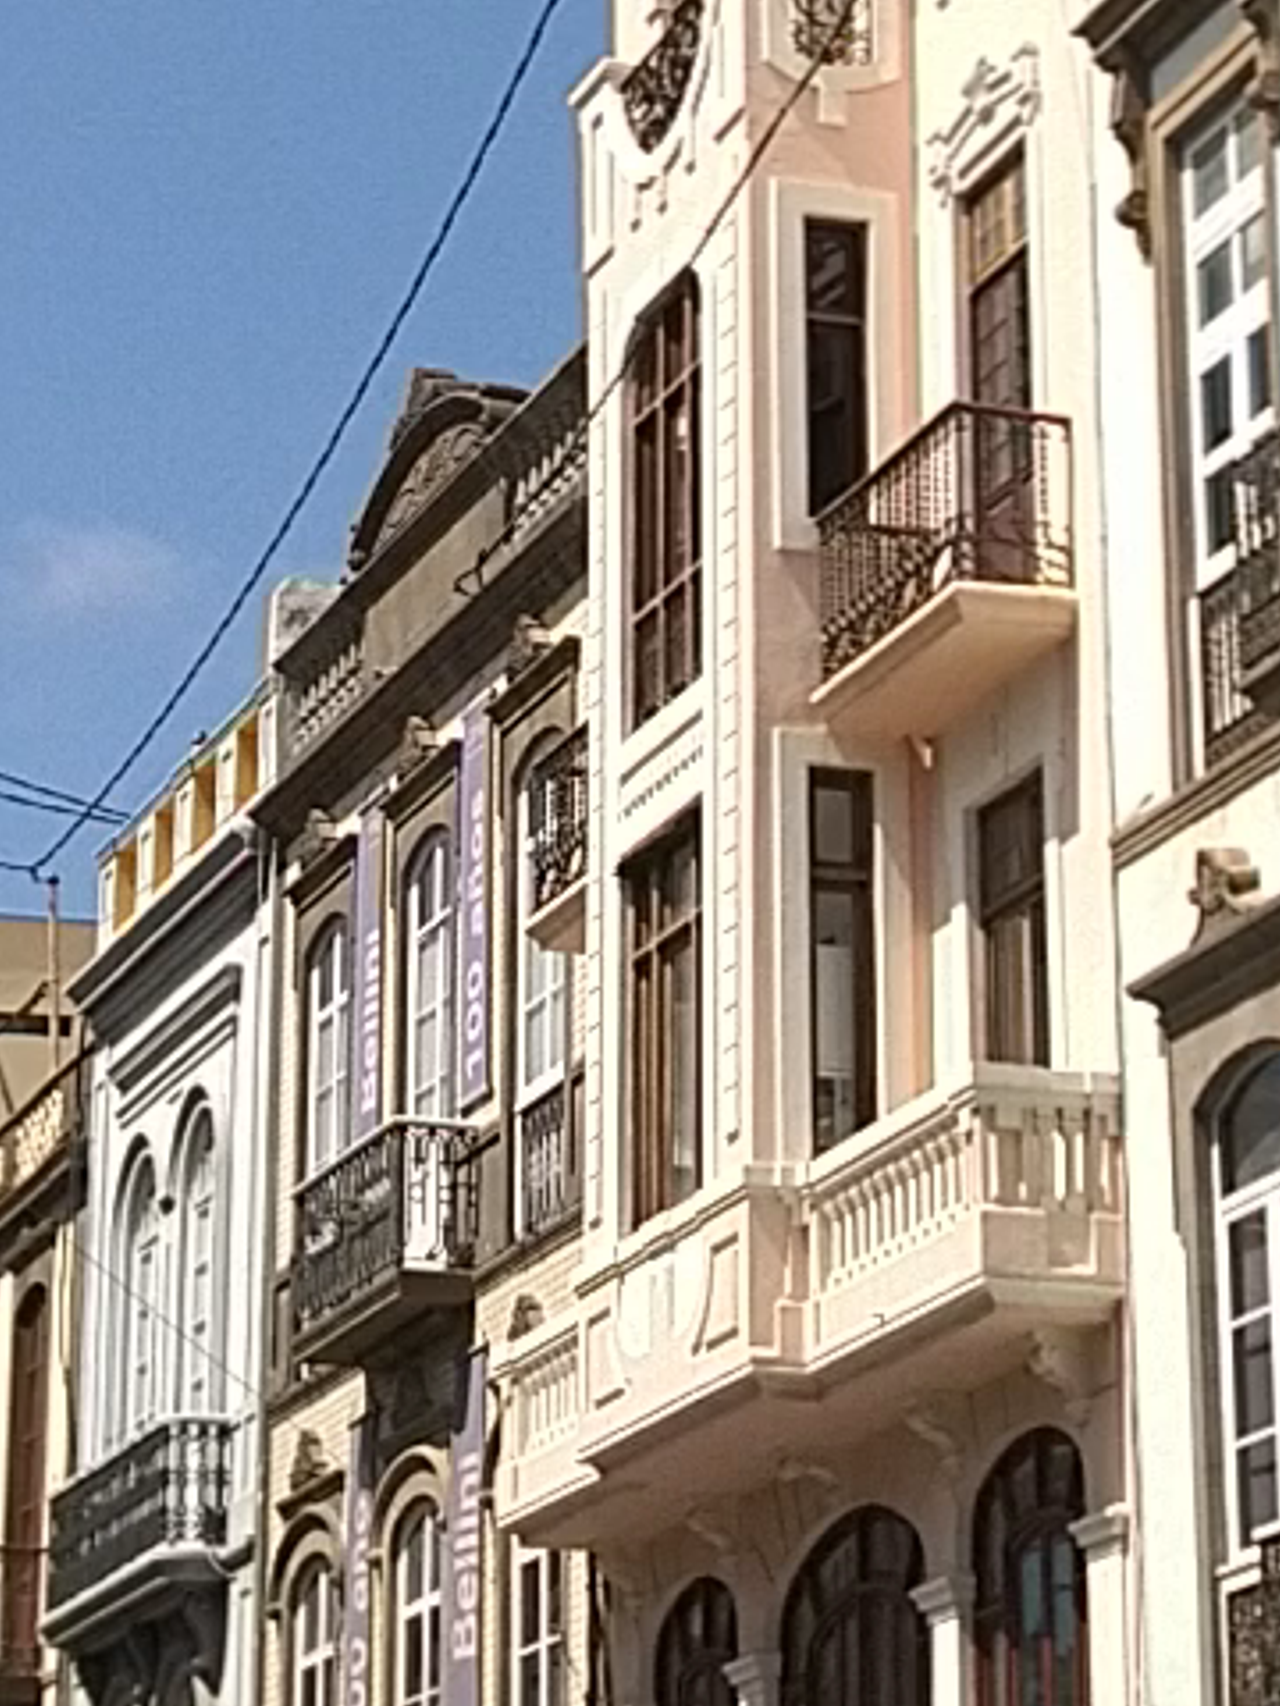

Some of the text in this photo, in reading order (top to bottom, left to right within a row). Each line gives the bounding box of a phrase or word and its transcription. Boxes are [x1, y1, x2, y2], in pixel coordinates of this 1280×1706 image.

[360, 928, 381, 1114] Bellini
[467, 960, 487, 1080] 100
[452, 1452, 481, 1658] Bellini
